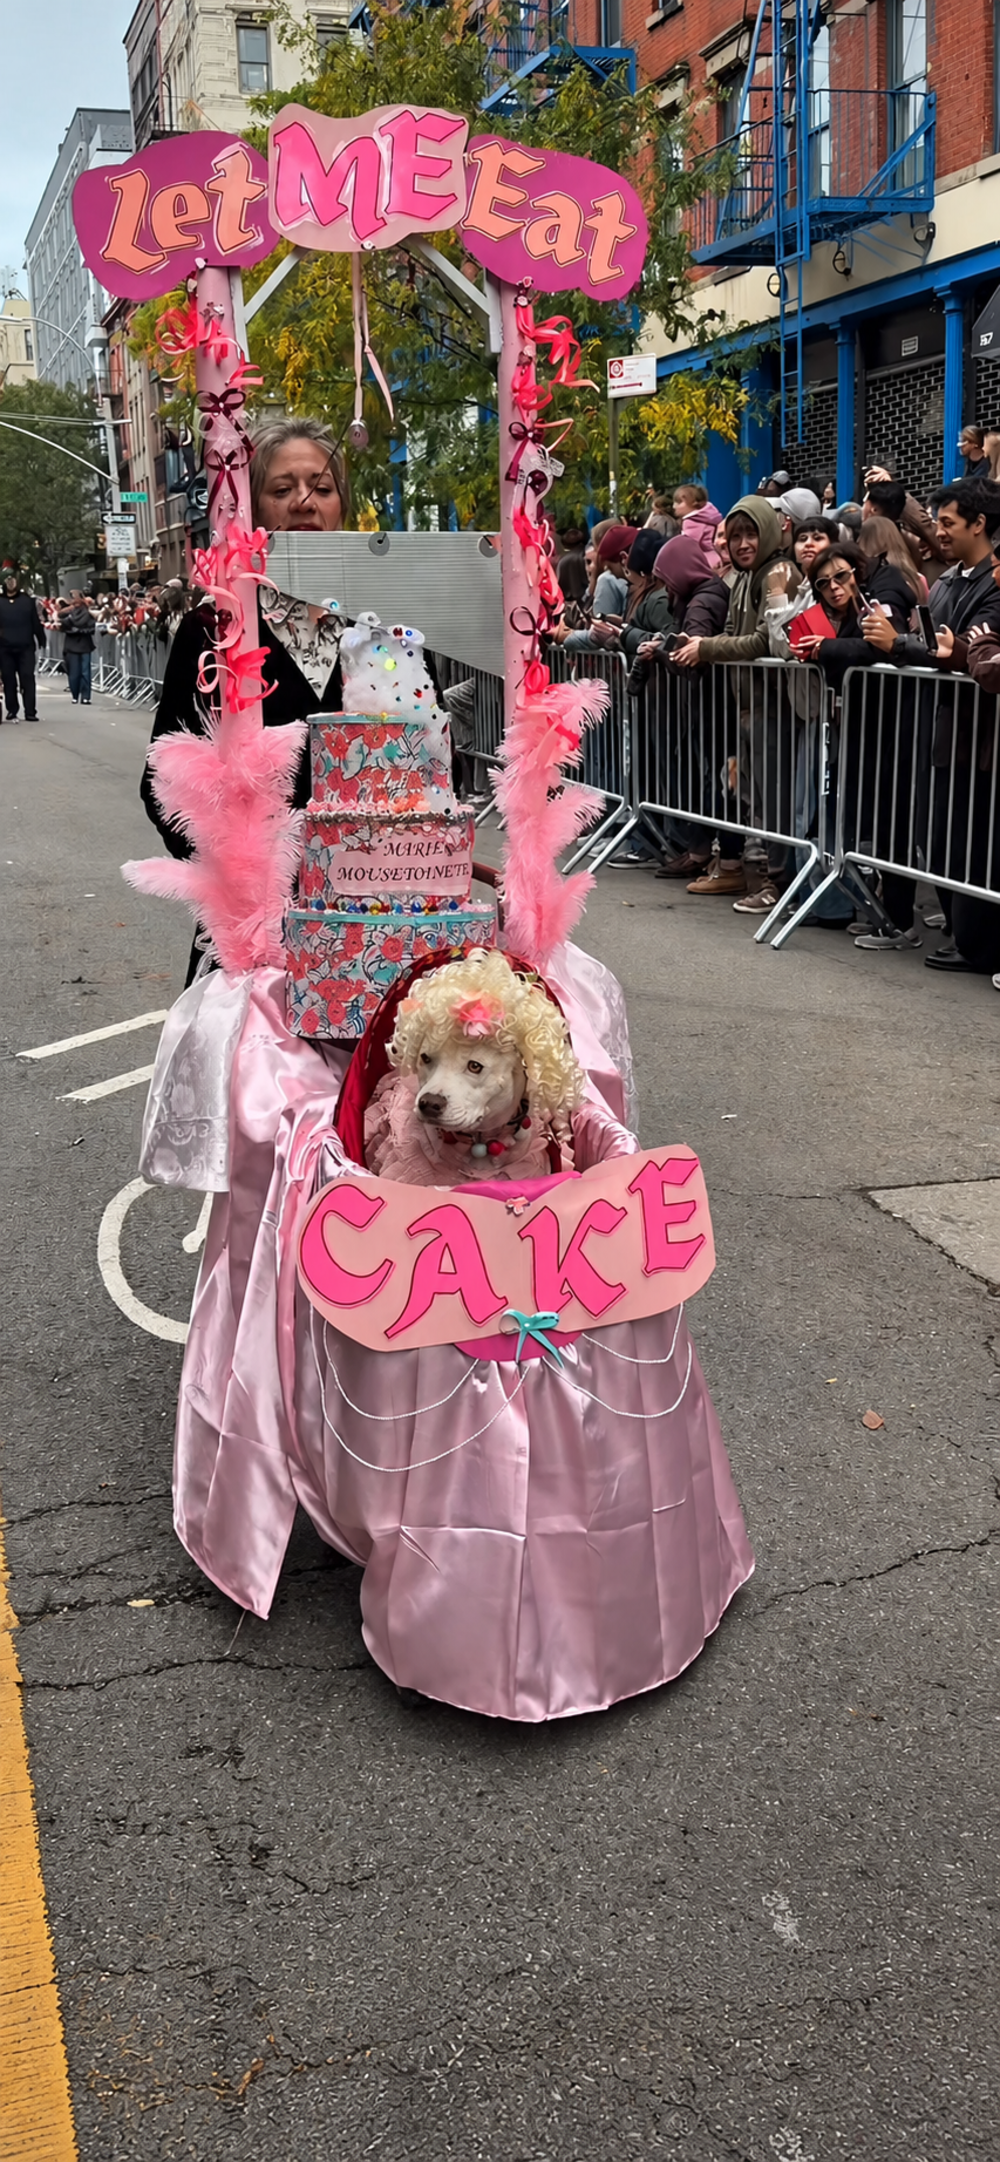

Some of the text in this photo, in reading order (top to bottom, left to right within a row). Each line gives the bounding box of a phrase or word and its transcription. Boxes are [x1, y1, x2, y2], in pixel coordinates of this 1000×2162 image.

[101, 109, 639, 287] Let ME Eat
[299, 1157, 707, 1340] CAKE
